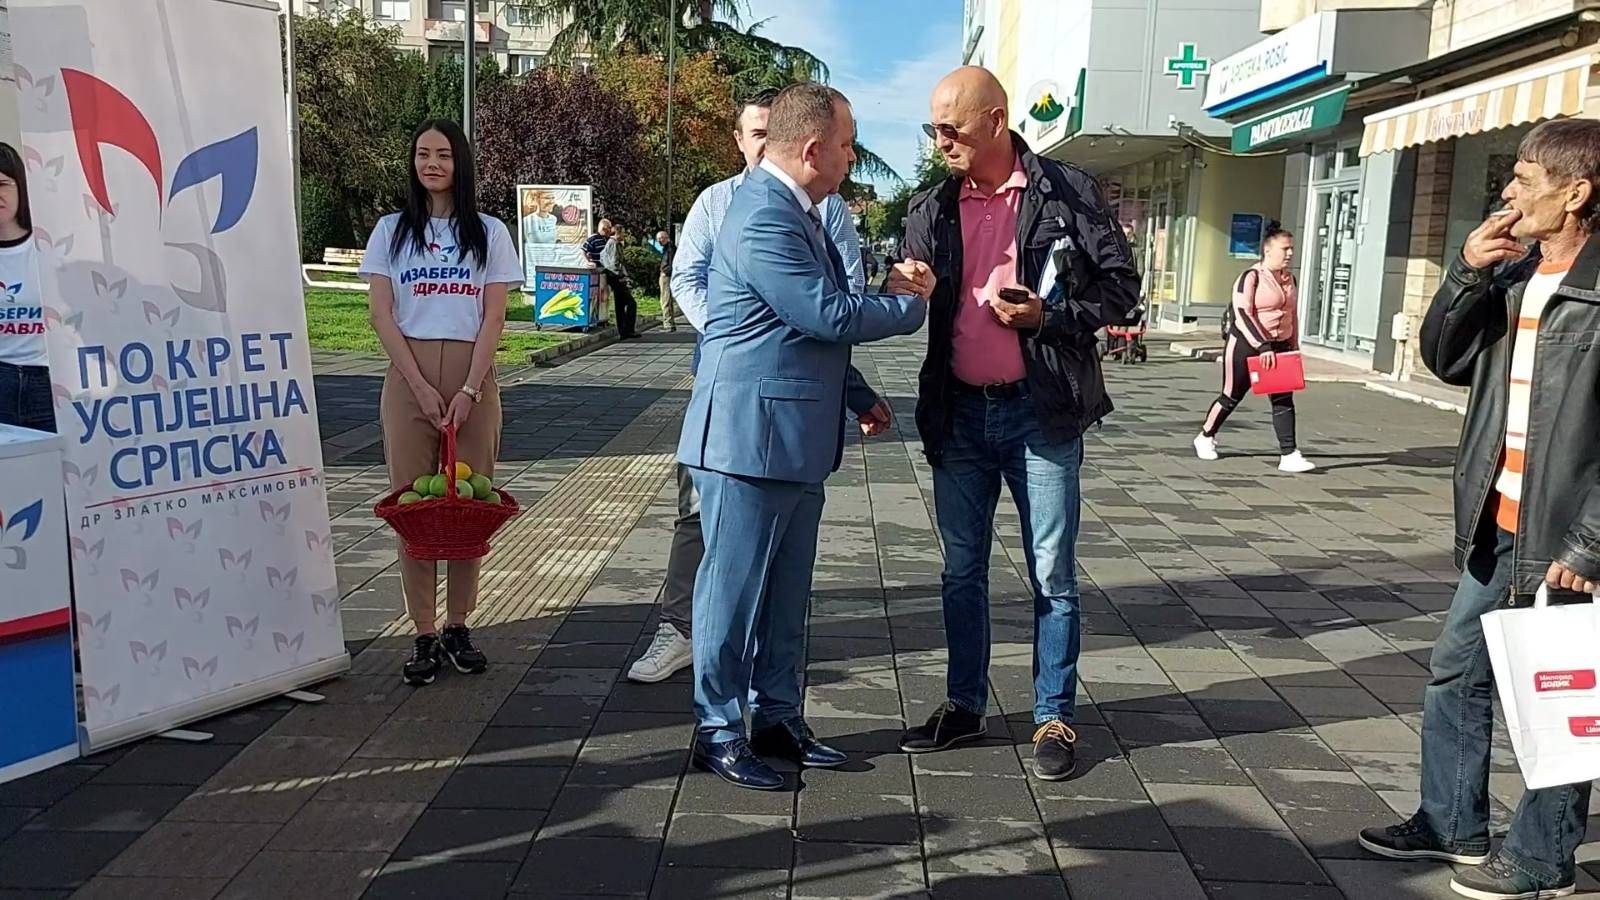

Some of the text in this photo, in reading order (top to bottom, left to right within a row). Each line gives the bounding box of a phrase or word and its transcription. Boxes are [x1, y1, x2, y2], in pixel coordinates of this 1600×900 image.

[400, 266, 471, 285] ИЗАБЕРИ
[77, 332, 293, 389] ПОКРЕТ
[73, 378, 309, 444] УСПЈЕШНА
[110, 428, 287, 489] СРПСКА
[80, 476, 319, 529] ДР ЗЛАТКО МАКСИМОВИЋ
